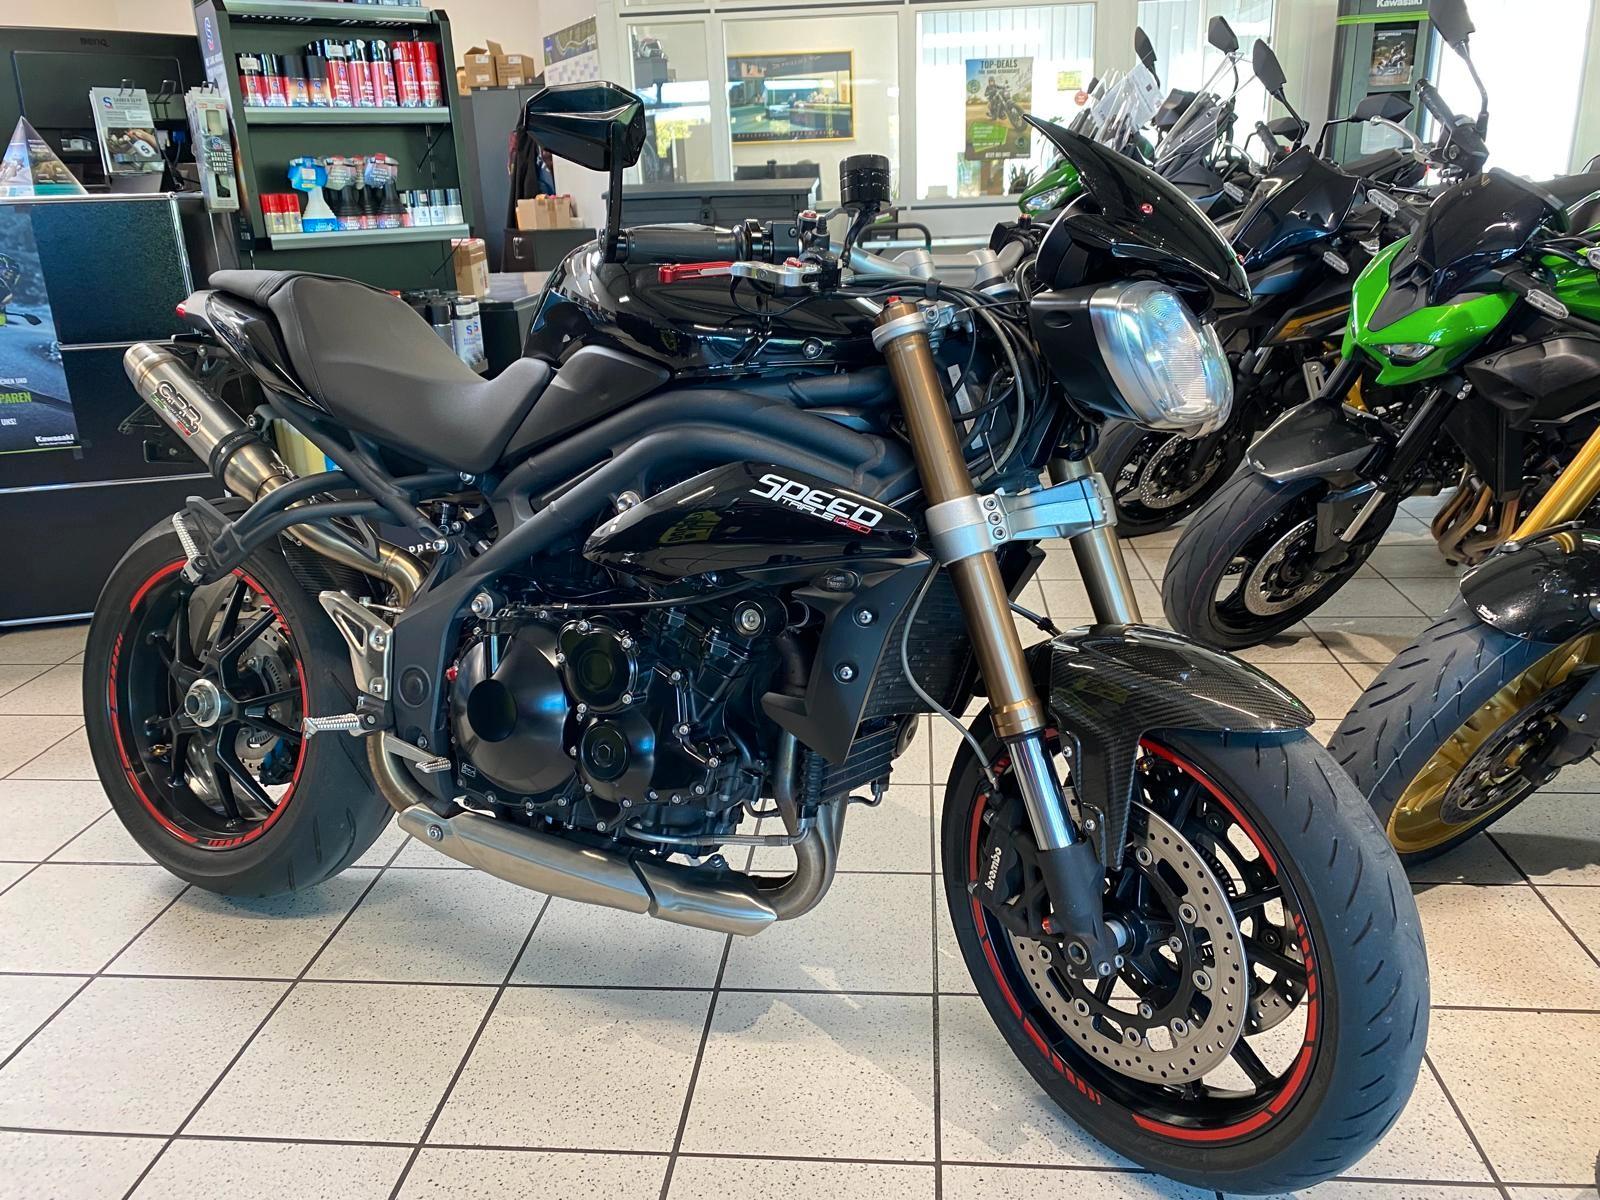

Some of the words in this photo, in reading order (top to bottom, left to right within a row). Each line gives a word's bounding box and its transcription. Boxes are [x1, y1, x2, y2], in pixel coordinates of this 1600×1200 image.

[35, 434, 74, 443] Kawasaki
[749, 473, 883, 527] SPEED
[781, 496, 836, 521] TRIPLE
[834, 516, 872, 534] 1050
[984, 846, 1002, 891] brembo
